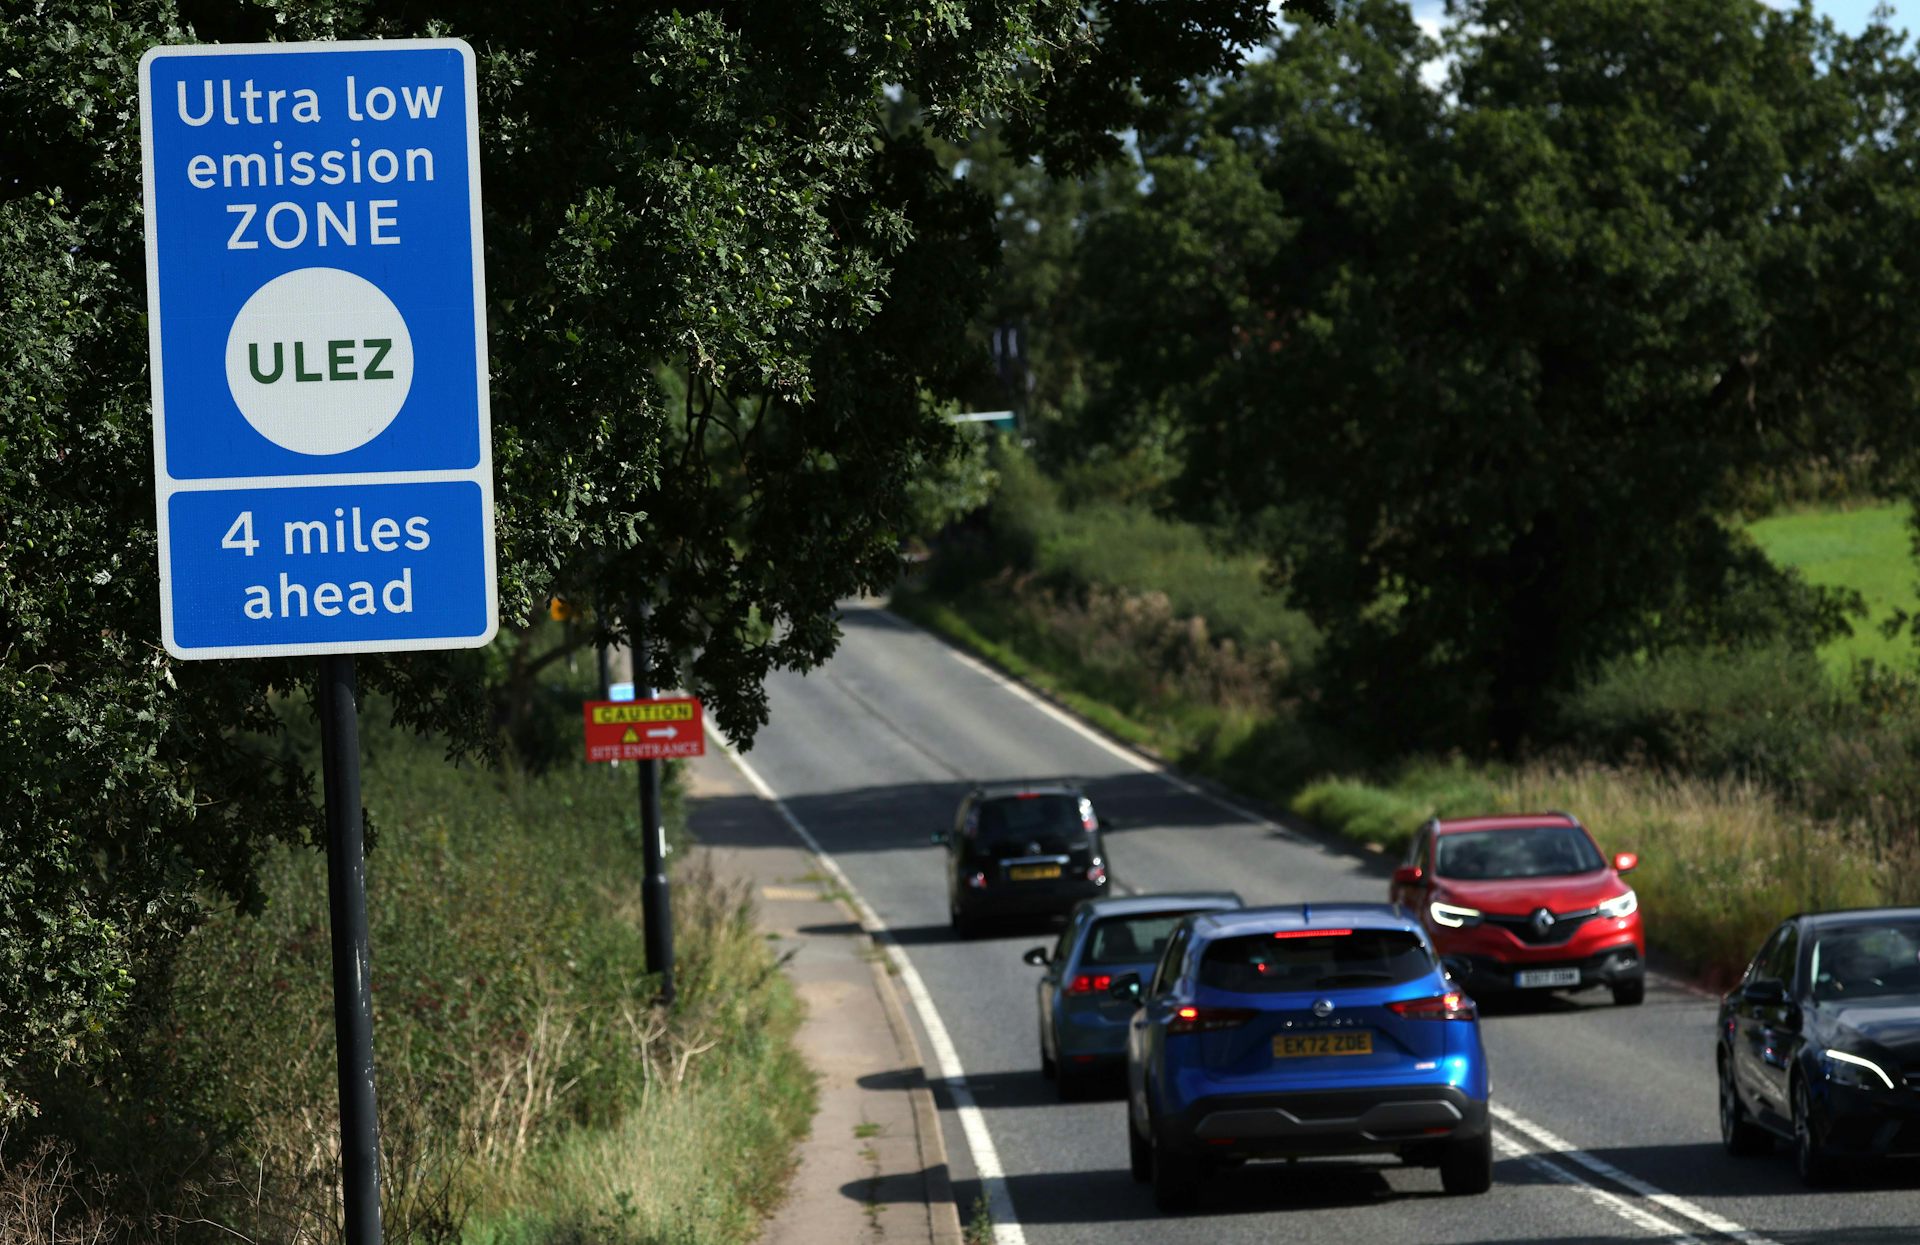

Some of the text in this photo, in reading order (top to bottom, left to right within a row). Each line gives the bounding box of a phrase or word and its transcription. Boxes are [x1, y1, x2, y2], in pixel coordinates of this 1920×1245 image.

[178, 76, 442, 126] Ultra low
[188, 139, 433, 188] emission
[227, 200, 400, 249] ZONE
[249, 339, 393, 384] ULEZ
[222, 507, 430, 556] 4 miles
[244, 568, 412, 619] ahead
[601, 705, 688, 721] CAUTION
[591, 742, 698, 759] SITE ENTRANCE
[1285, 1035, 1328, 1053] EK72
